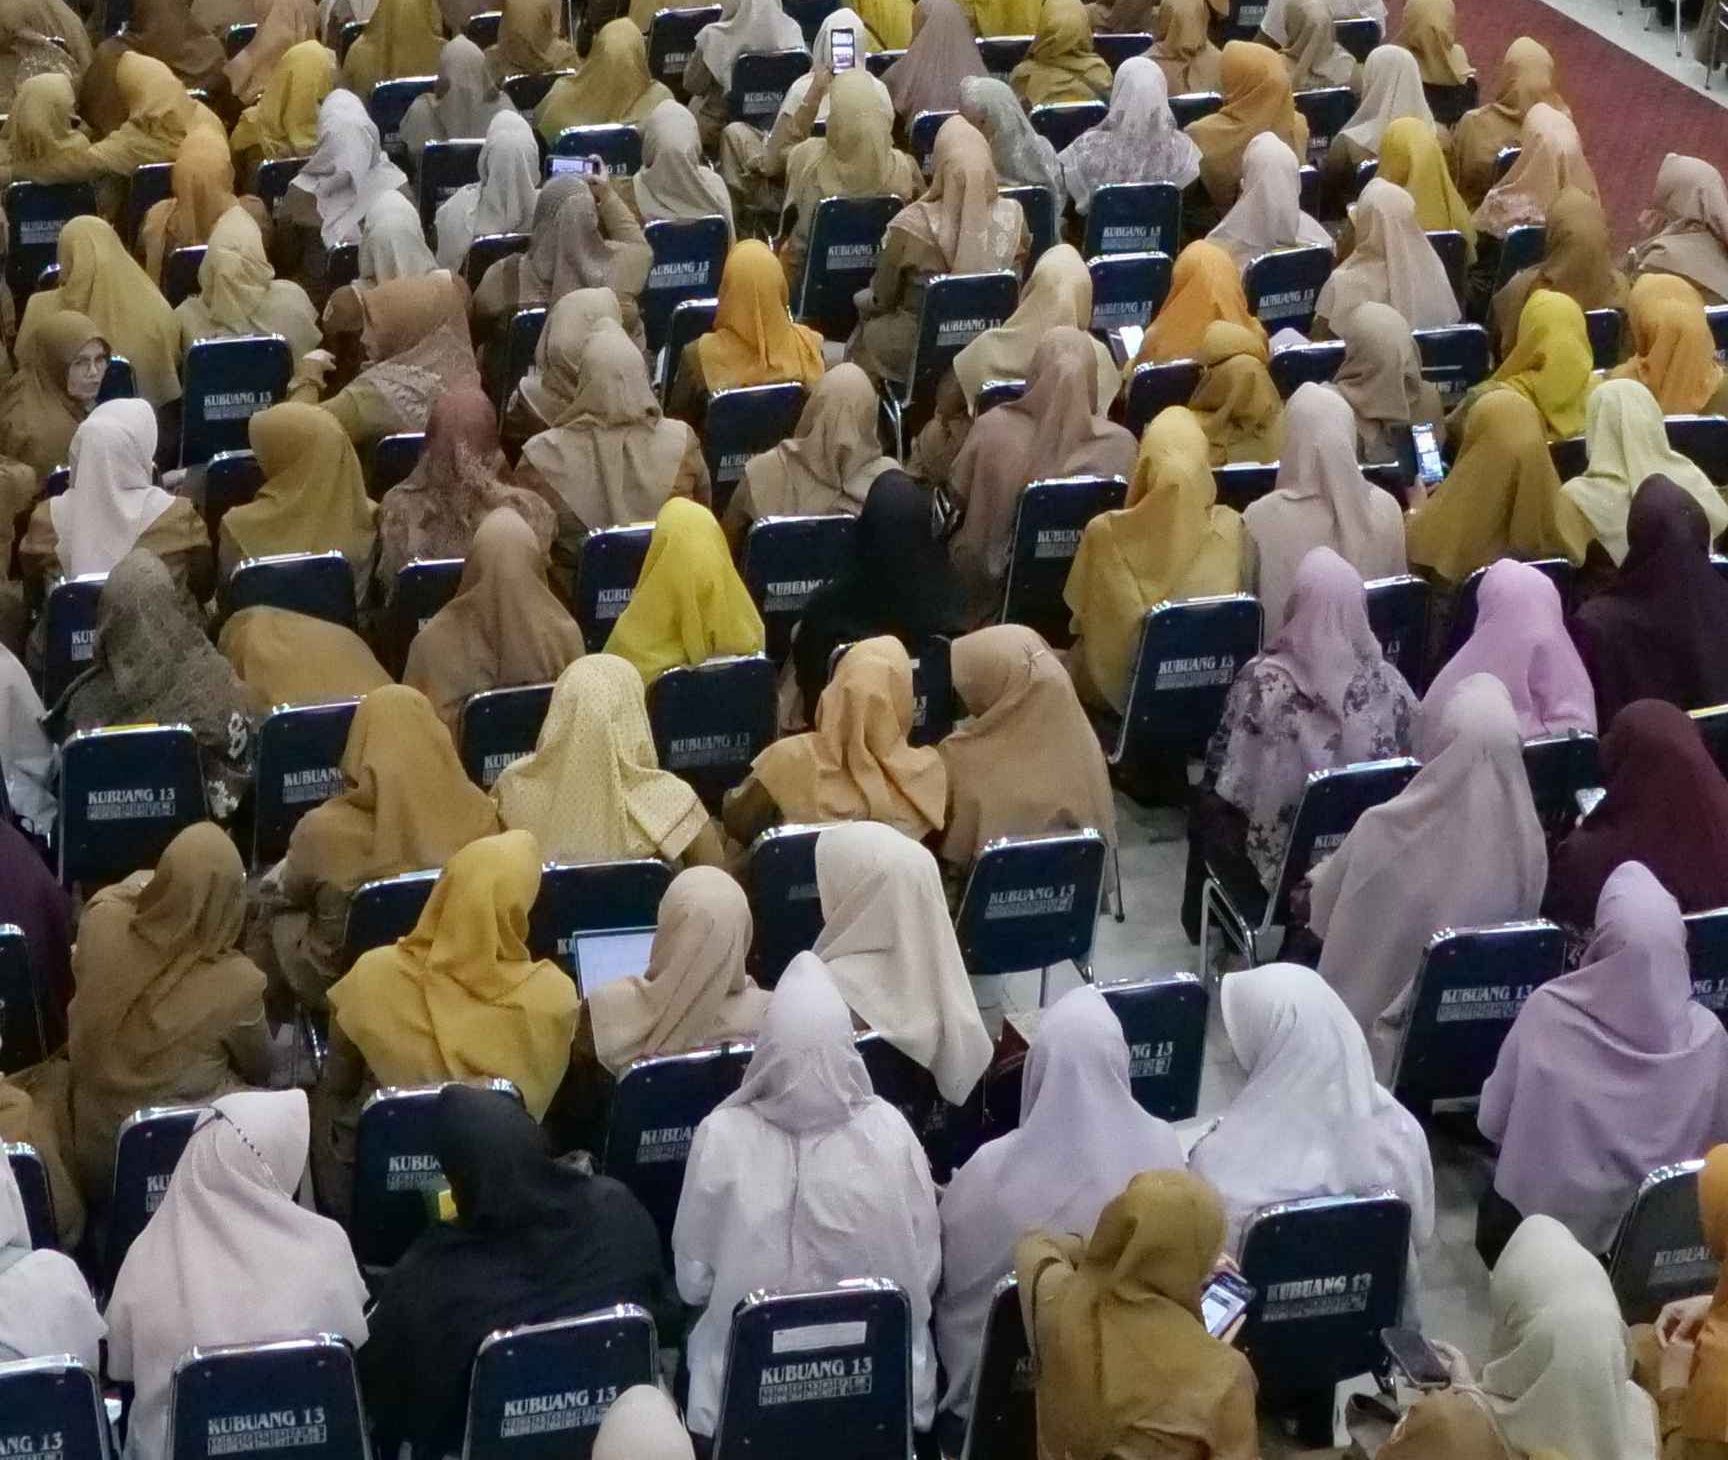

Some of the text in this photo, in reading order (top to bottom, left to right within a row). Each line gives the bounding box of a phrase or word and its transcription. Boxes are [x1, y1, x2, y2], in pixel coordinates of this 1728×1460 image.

[203, 391, 273, 407] KUBUANG 13
[1037, 529, 1081, 544] KUBUA
[597, 588, 632, 604] KUBU
[1158, 655, 1235, 675] KUBUANG 13
[88, 786, 176, 805] KUBUANG 13
[988, 882, 1077, 906] KUBUANG 13
[1440, 986, 1511, 1005] KUBUANG
[1156, 1041, 1175, 1057] 13
[640, 1127, 696, 1147] KUBUA
[388, 1154, 443, 1173] KUBUA
[1653, 1244, 1713, 1268] KUBUA
[760, 1355, 873, 1387] KUBUANG 13
[503, 1385, 618, 1418] KUBUANG 13
[207, 1406, 326, 1437] KUBUANG 13
[41, 1430, 64, 1451] 13
